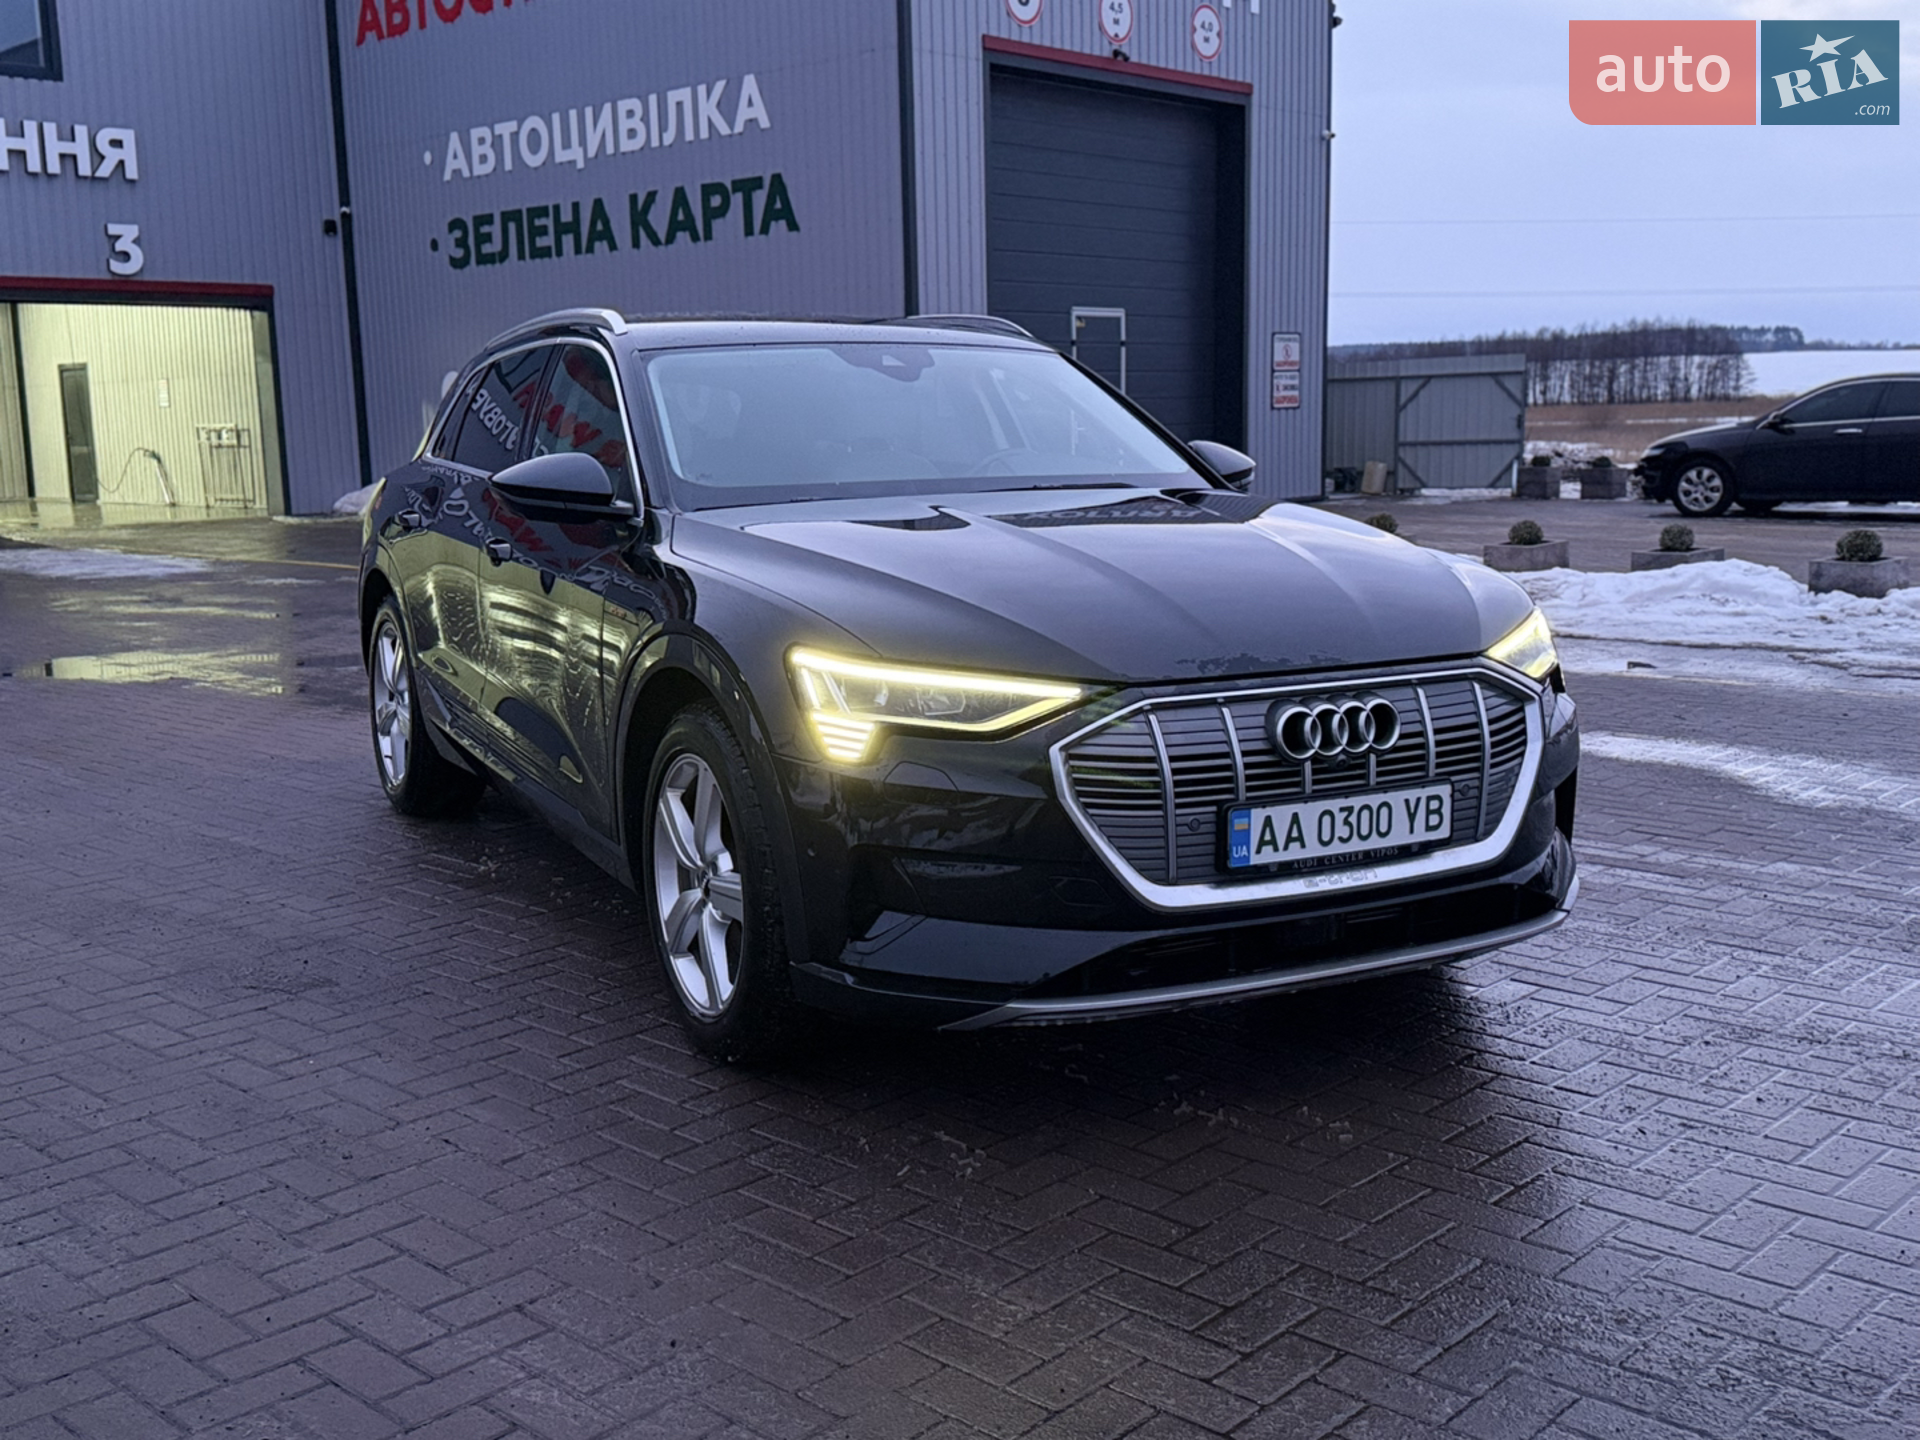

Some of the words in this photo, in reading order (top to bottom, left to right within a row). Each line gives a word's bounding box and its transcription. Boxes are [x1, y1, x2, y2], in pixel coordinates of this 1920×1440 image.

[443, 73, 771, 181] АВТОЦИВІЛКА
[106, 222, 145, 276] 3
[447, 197, 618, 270] ЗЕЛЕНА
[628, 172, 800, 250] КАРТА
[1232, 845, 1249, 858] UA
[1255, 812, 1306, 855] AA
[1317, 801, 1393, 848] 0300
[1404, 794, 1445, 835] YB
[1292, 858, 1317, 869] AUDI
[1324, 852, 1364, 865] CENTER
[1370, 847, 1399, 858] VIPOS
